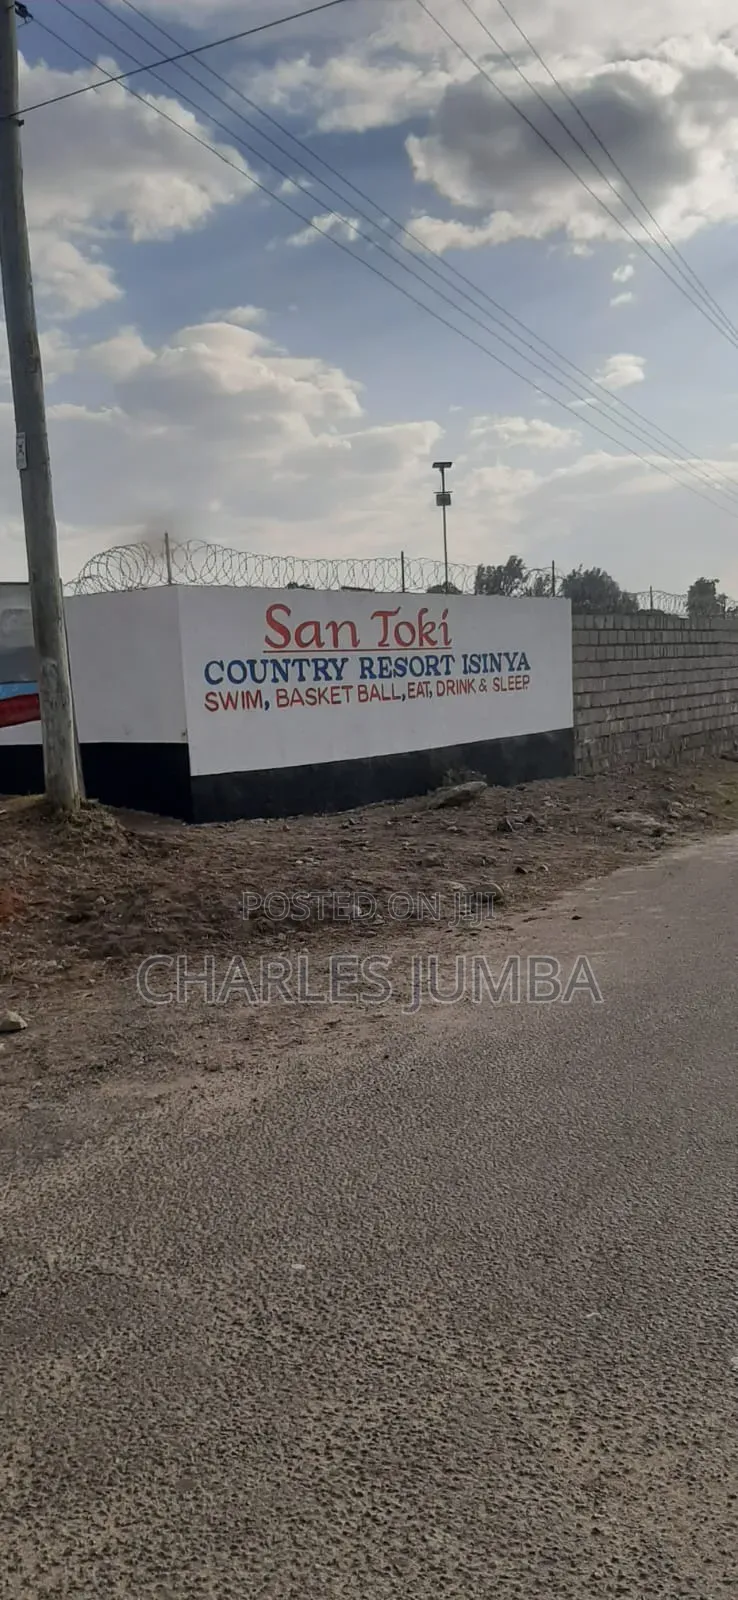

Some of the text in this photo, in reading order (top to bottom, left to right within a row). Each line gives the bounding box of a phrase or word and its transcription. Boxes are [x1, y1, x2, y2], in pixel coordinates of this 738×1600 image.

[264, 603, 452, 649] San Toki
[204, 651, 531, 685] COUNTRY RESORT ISINYA
[204, 689, 270, 712] SWIM,
[276, 684, 353, 708] BASKET
[436, 678, 476, 697] DRINK
[478, 678, 488, 693] &
